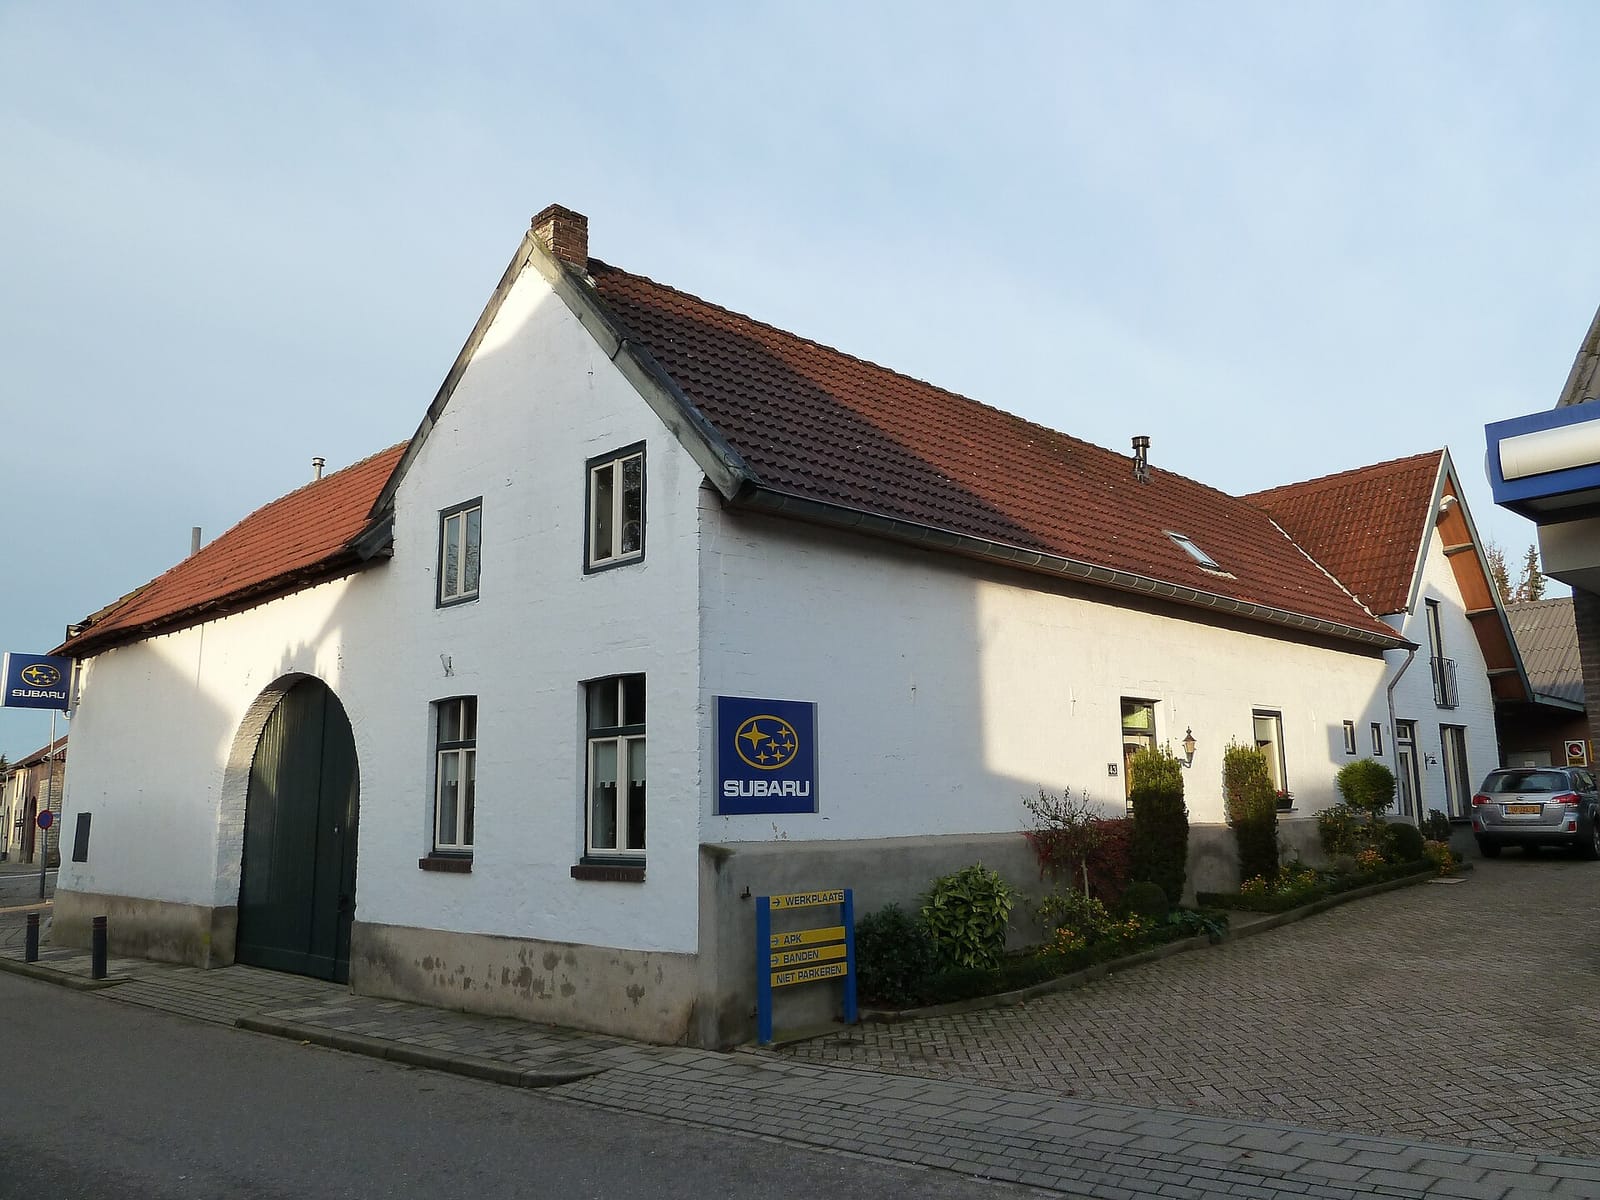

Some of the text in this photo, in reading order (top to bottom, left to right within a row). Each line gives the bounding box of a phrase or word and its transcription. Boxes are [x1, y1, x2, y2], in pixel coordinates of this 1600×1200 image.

[11, 689, 66, 699] SUBARU
[723, 780, 810, 797] SUBARU
[785, 892, 844, 905] WERKPLAATS
[783, 934, 802, 944] APK
[783, 950, 819, 964] BANDEN
[776, 965, 842, 984] NIET PARKEREN
